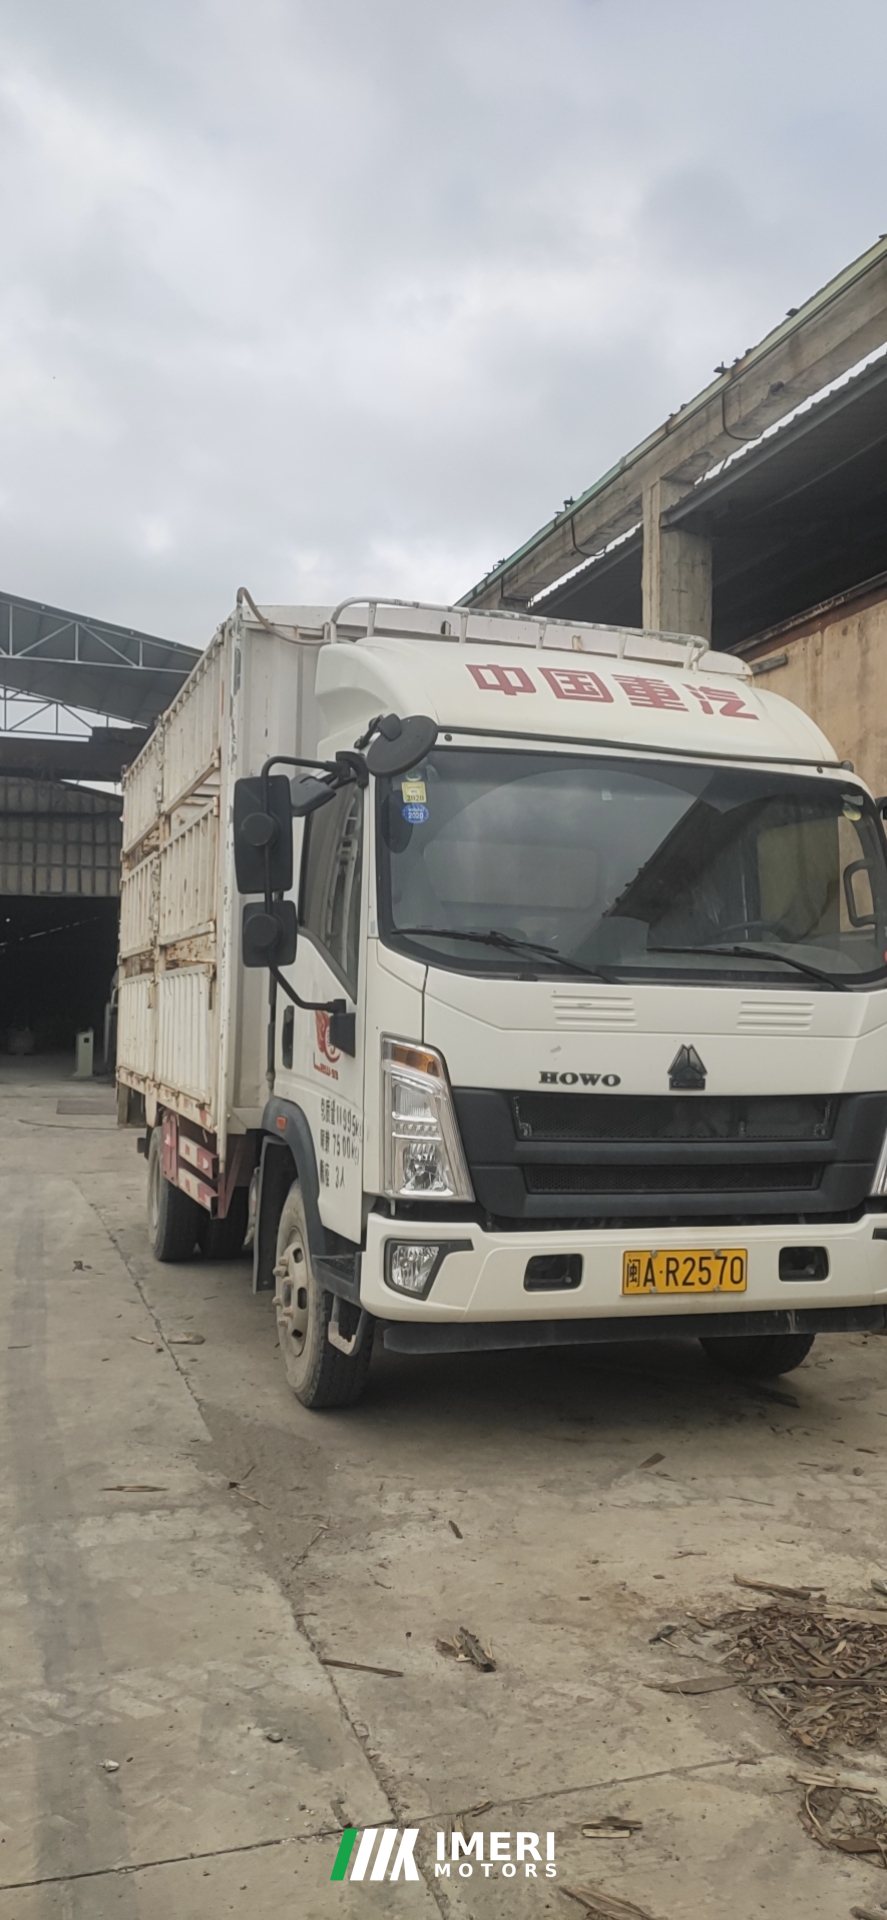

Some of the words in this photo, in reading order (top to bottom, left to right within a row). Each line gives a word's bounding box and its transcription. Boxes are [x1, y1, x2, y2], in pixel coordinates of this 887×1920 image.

[465, 664, 759, 720] 中国重汽
[539, 1071, 621, 1087] HOWO
